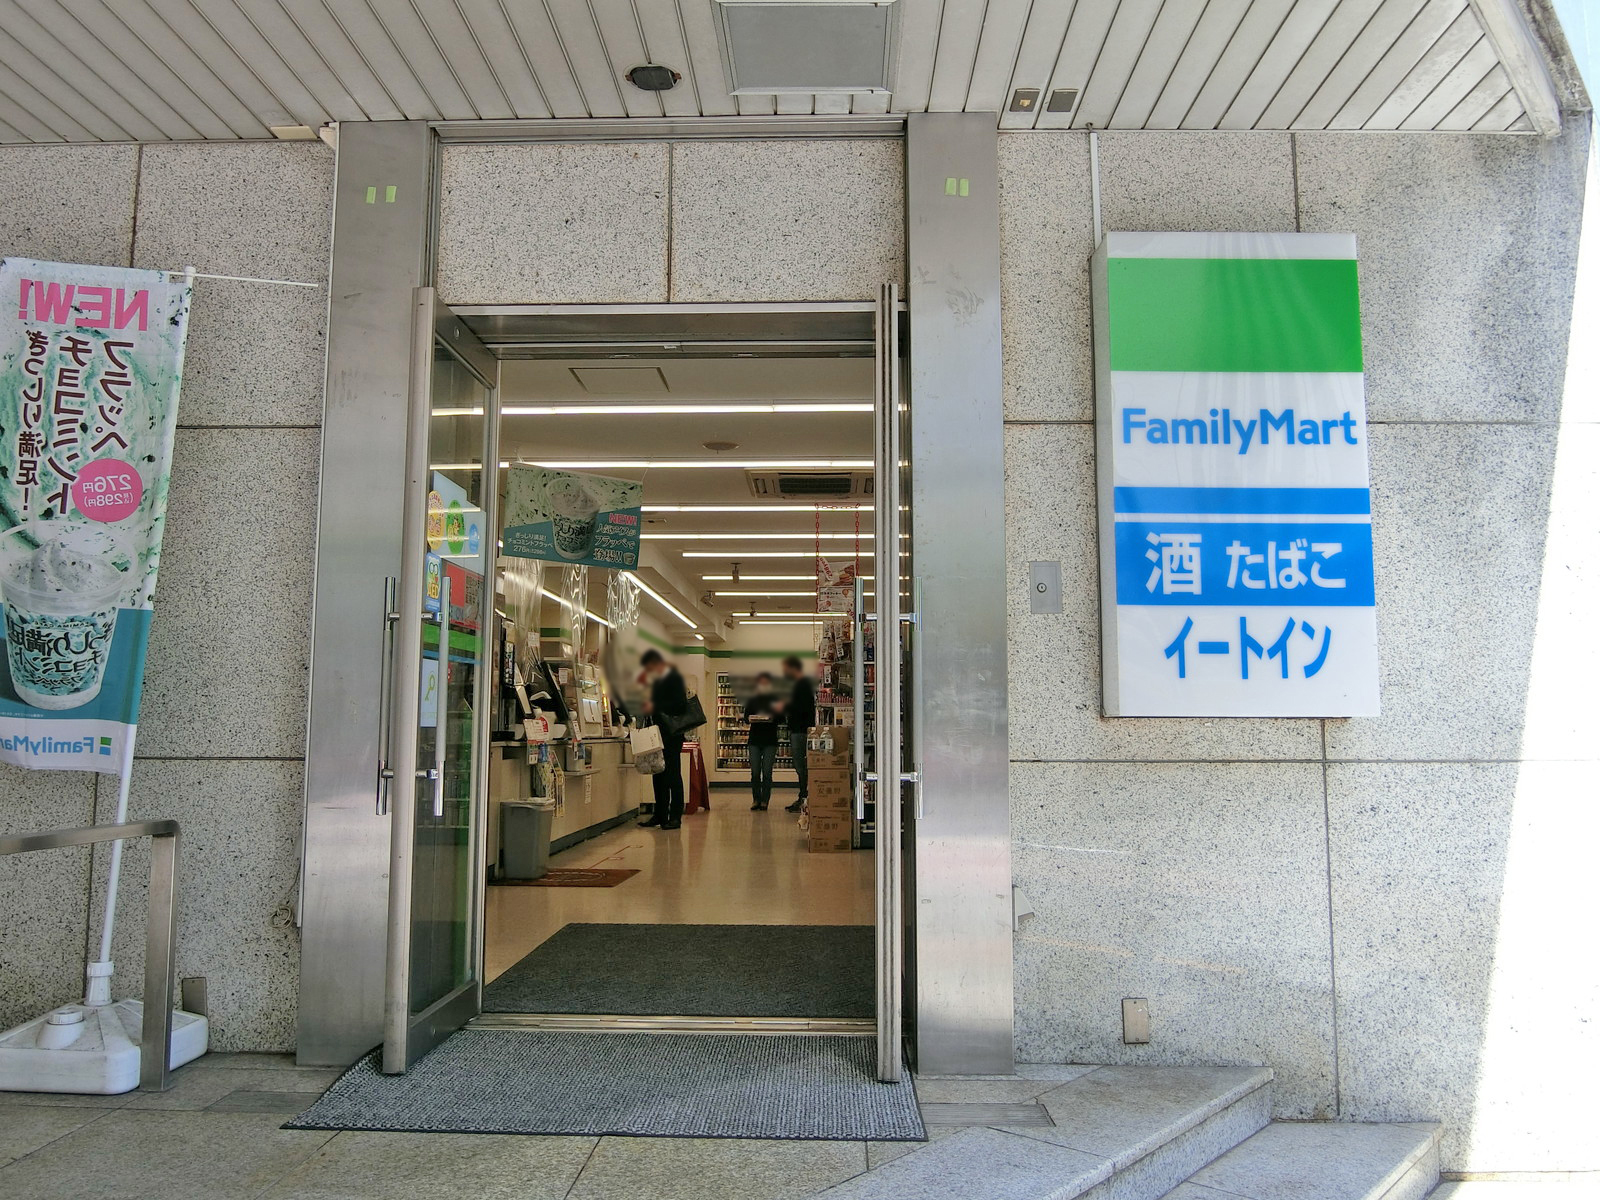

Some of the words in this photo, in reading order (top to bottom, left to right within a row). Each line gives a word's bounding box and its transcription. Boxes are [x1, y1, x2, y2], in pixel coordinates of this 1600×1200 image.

[1122, 407, 1358, 455] FamilyMart
[1145, 531, 1203, 595] 酒
[1225, 538, 1347, 590] たばこ
[1164, 615, 1332, 680] イートイン
